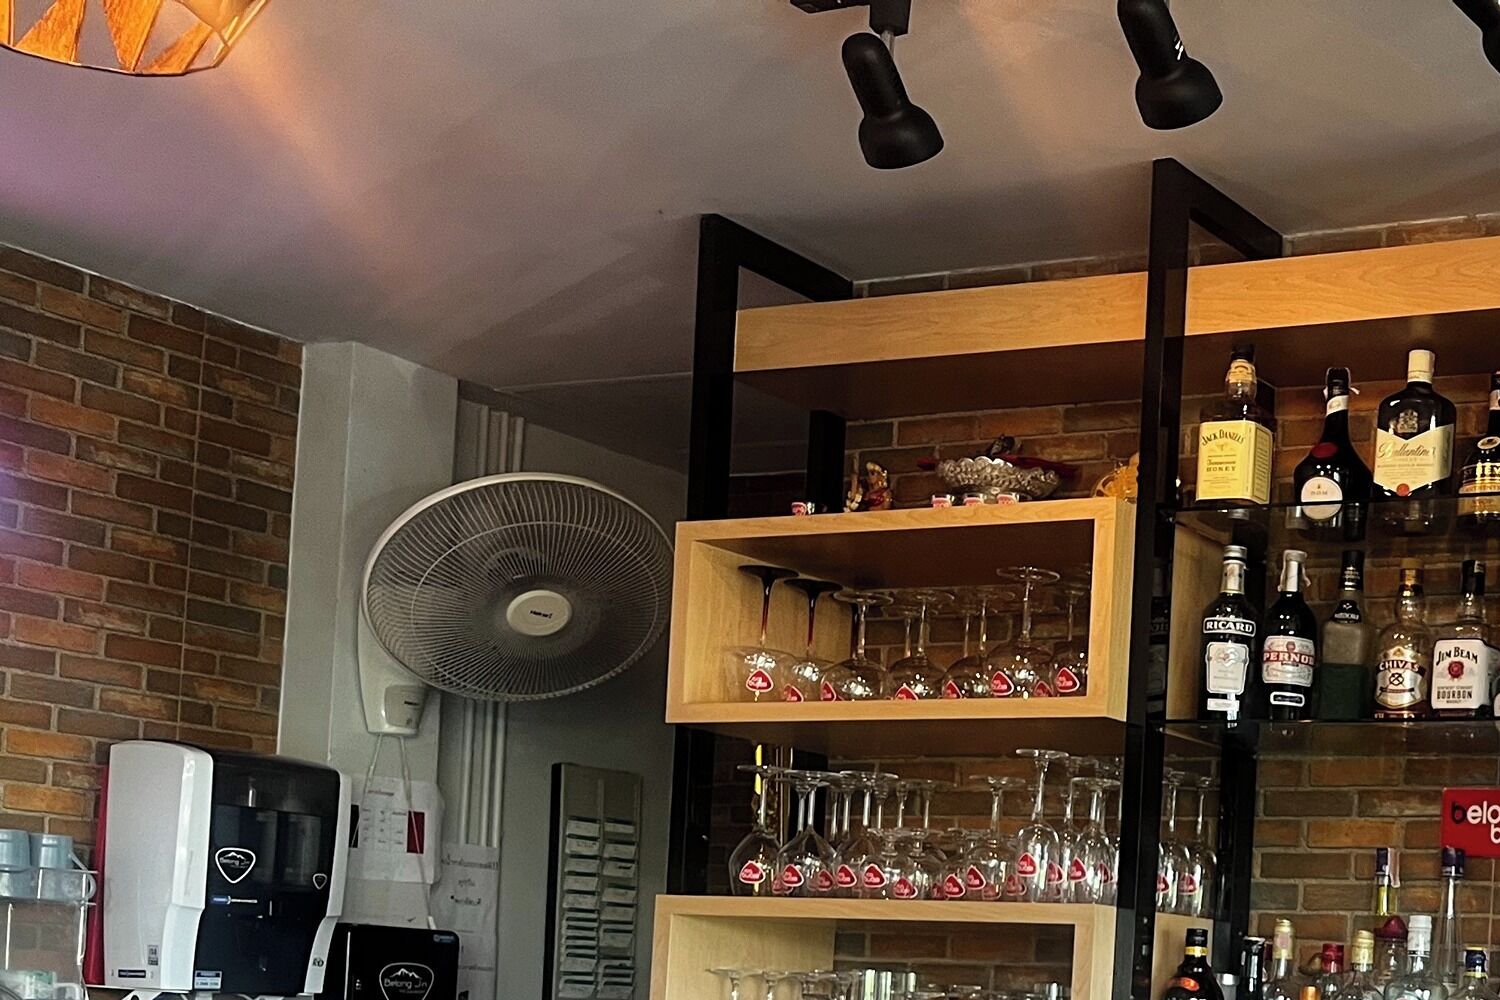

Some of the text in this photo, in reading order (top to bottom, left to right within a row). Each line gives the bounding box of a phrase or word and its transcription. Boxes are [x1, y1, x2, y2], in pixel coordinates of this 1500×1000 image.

[1206, 621, 1253, 633] RICARD
[1436, 646, 1479, 666] JIM BEAM
[1378, 660, 1419, 672] CHIVAS
[1437, 690, 1473, 699] BOURBON
